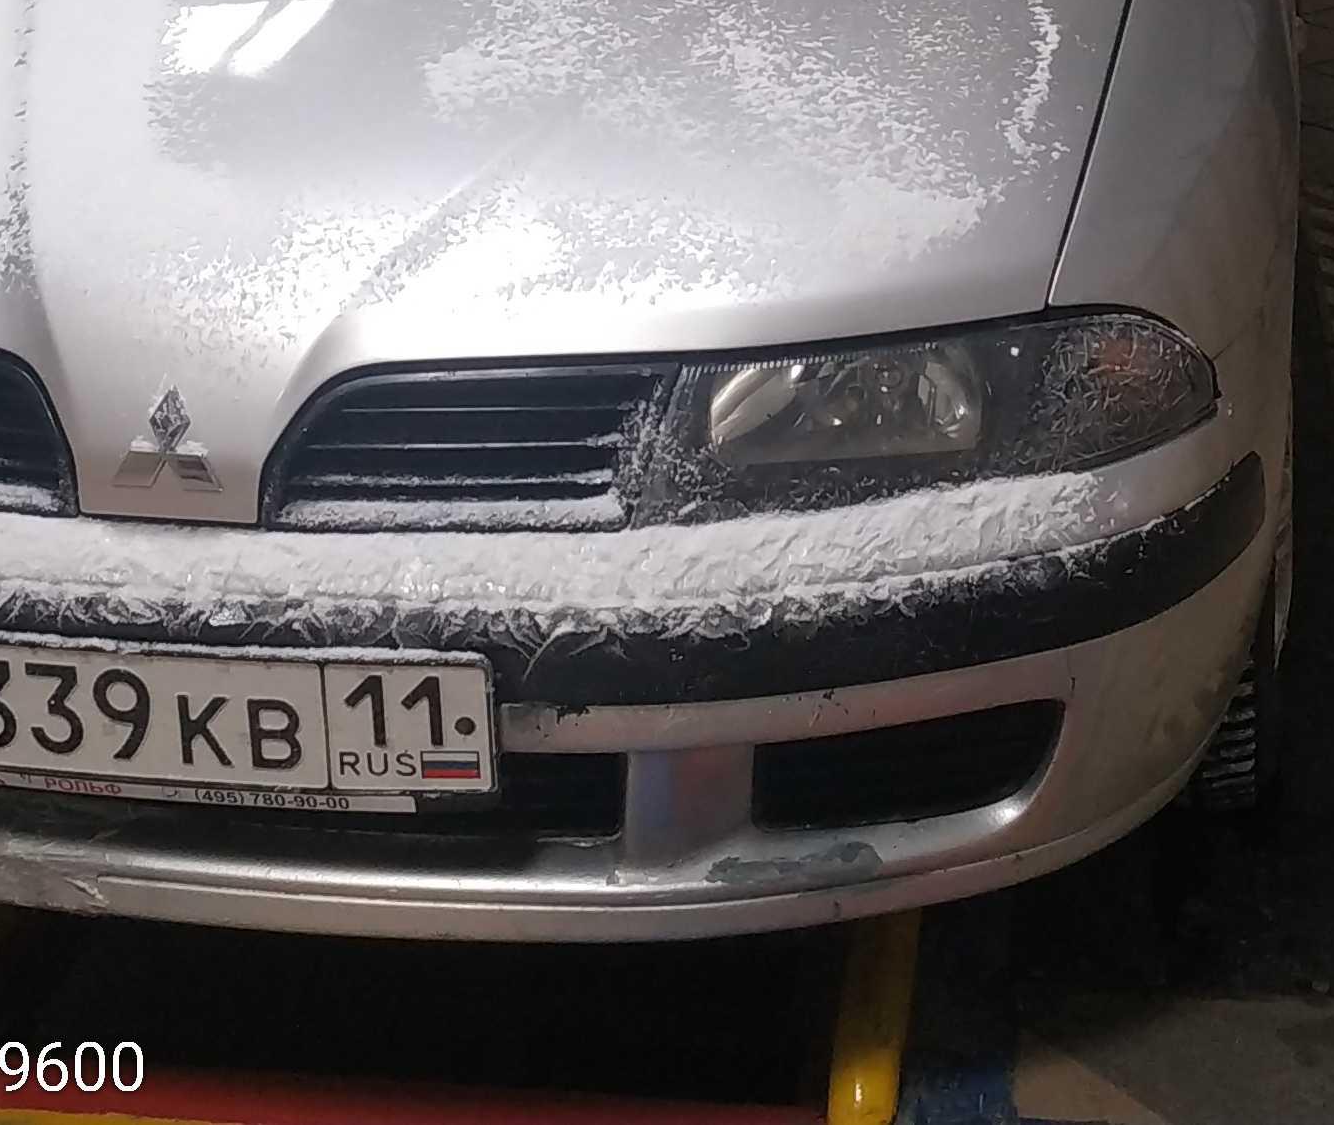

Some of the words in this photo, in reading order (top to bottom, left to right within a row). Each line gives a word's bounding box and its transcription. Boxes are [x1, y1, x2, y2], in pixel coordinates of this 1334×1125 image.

[344, 673, 444, 748] 11
[338, 751, 417, 778] RUS
[195, 789, 244, 806] (495)
[248, 791, 350, 810] 780-90-00
